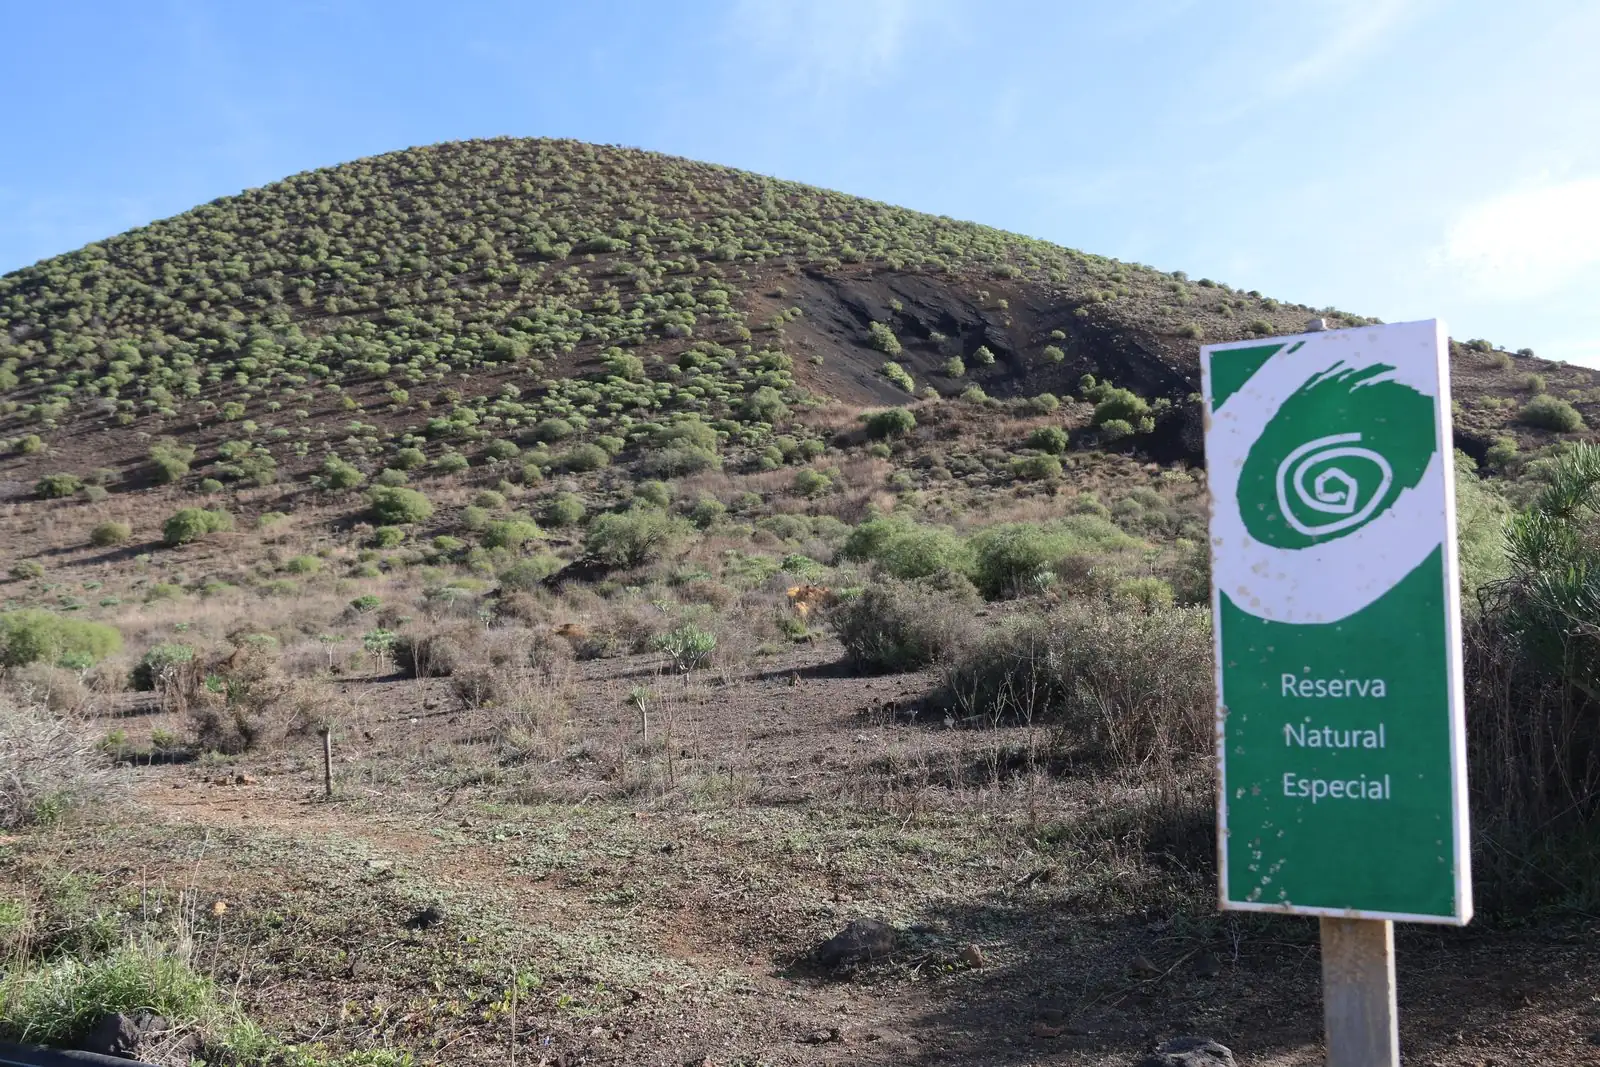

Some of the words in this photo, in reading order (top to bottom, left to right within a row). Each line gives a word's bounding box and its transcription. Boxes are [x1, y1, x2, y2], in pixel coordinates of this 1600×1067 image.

[1281, 673, 1386, 698] Reserva
[1284, 723, 1386, 748] Natural
[1283, 772, 1391, 804] Especial
